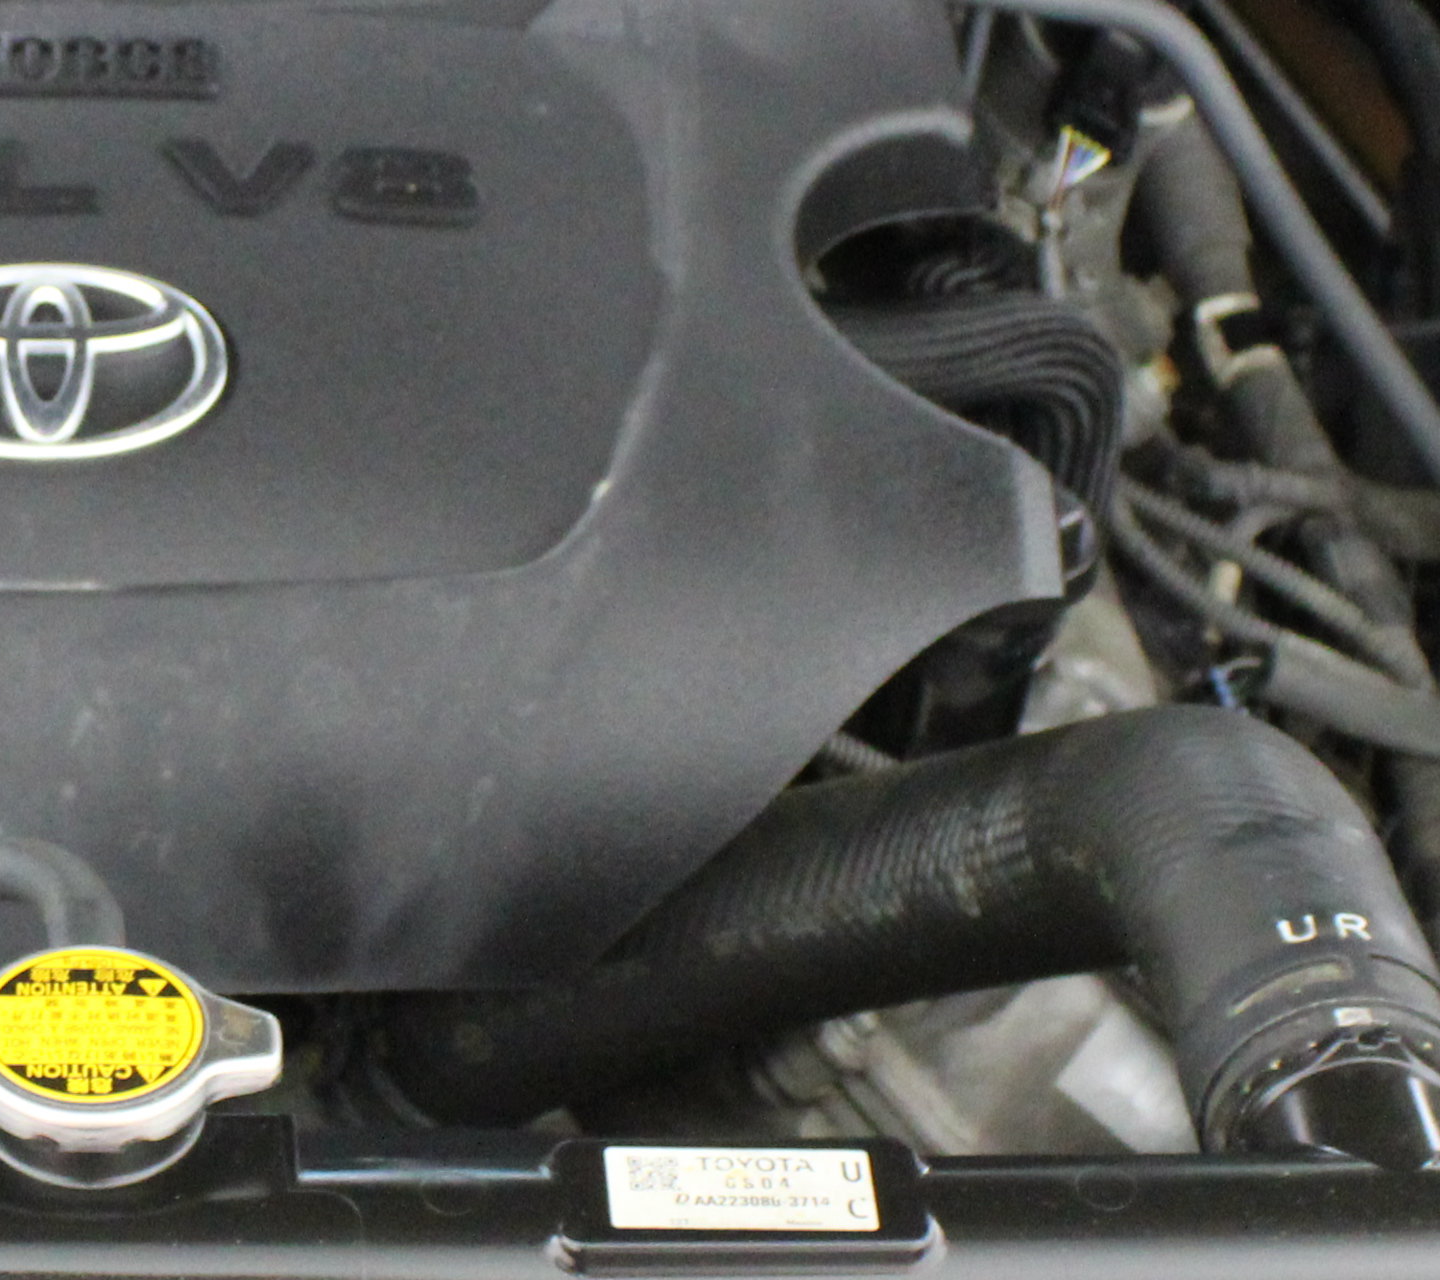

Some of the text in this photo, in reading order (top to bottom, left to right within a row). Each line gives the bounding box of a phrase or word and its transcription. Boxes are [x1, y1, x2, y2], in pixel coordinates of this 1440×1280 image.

[163, 138, 480, 228] V8
[15, 982, 127, 996] ATTENTION
[26, 1065, 133, 1079] CAUTION
[697, 1156, 814, 1173] TOYOTA
